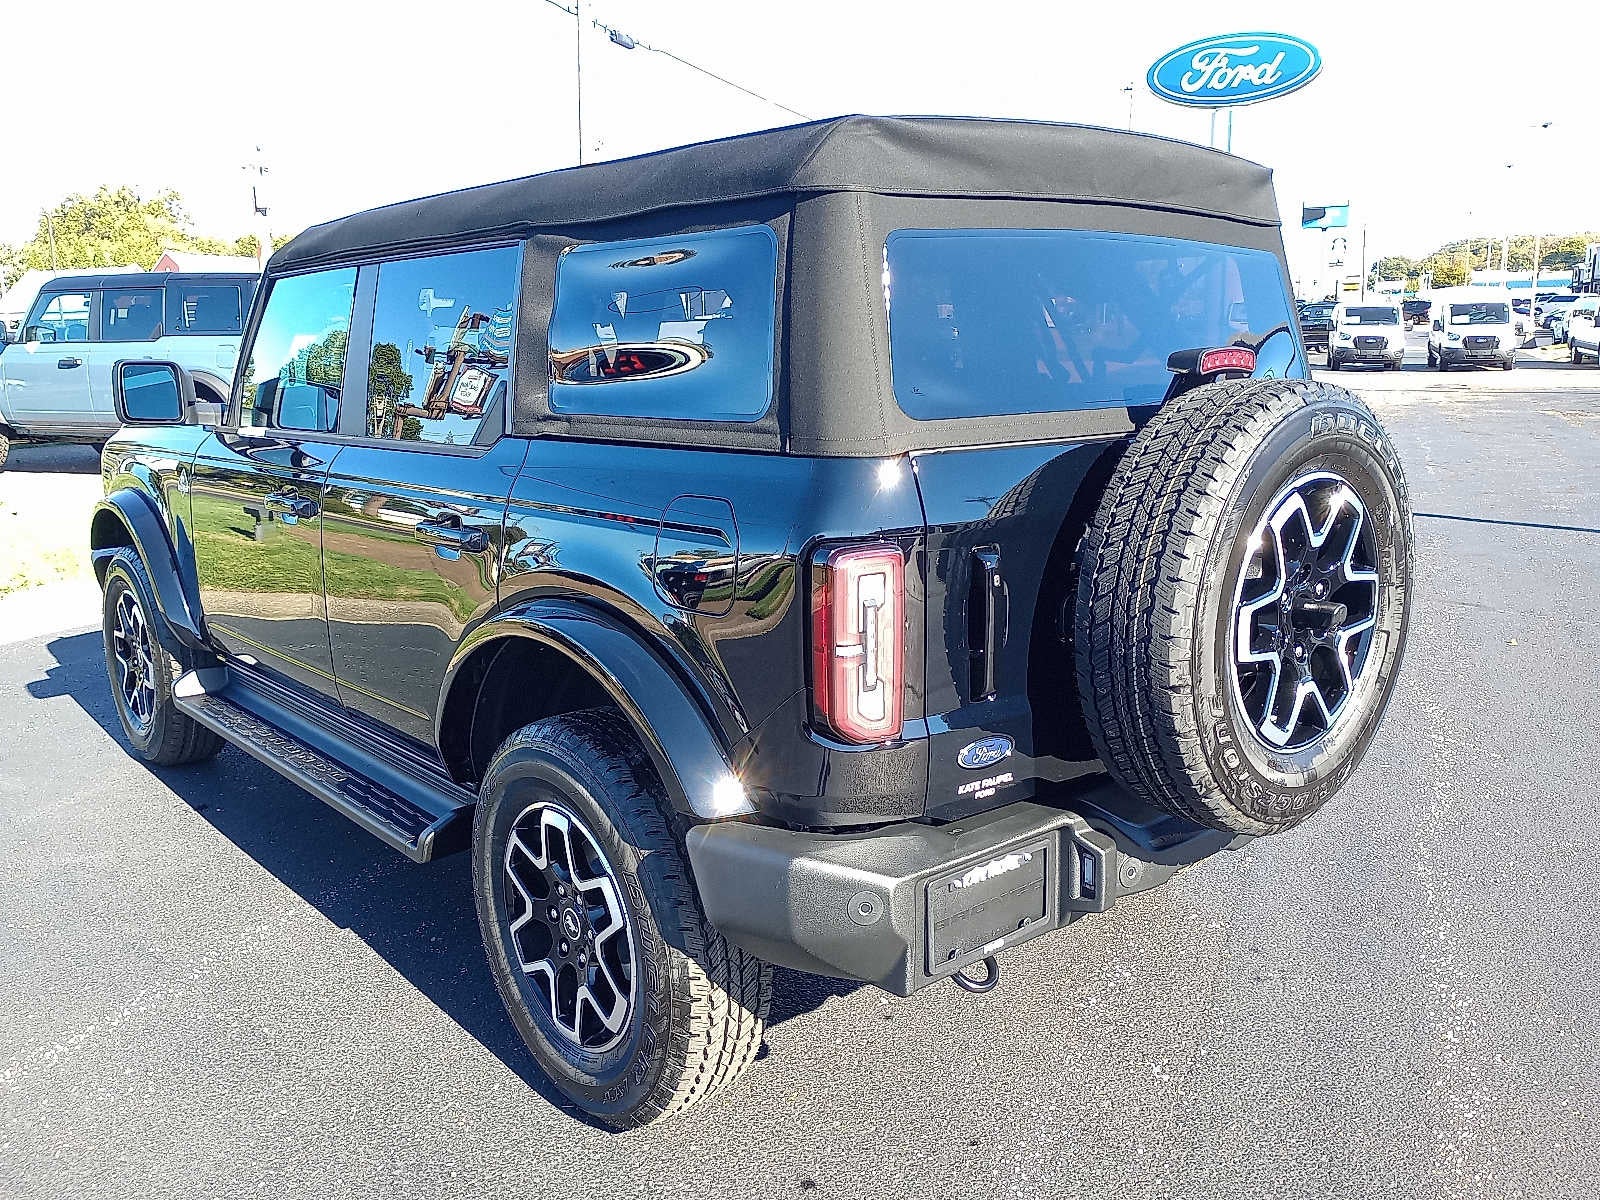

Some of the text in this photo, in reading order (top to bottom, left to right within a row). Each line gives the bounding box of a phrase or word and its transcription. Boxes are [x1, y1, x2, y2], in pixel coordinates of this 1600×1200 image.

[1180, 45, 1286, 93] Ford
[972, 742, 1003, 763] Ford
[957, 781, 981, 795] KATE
